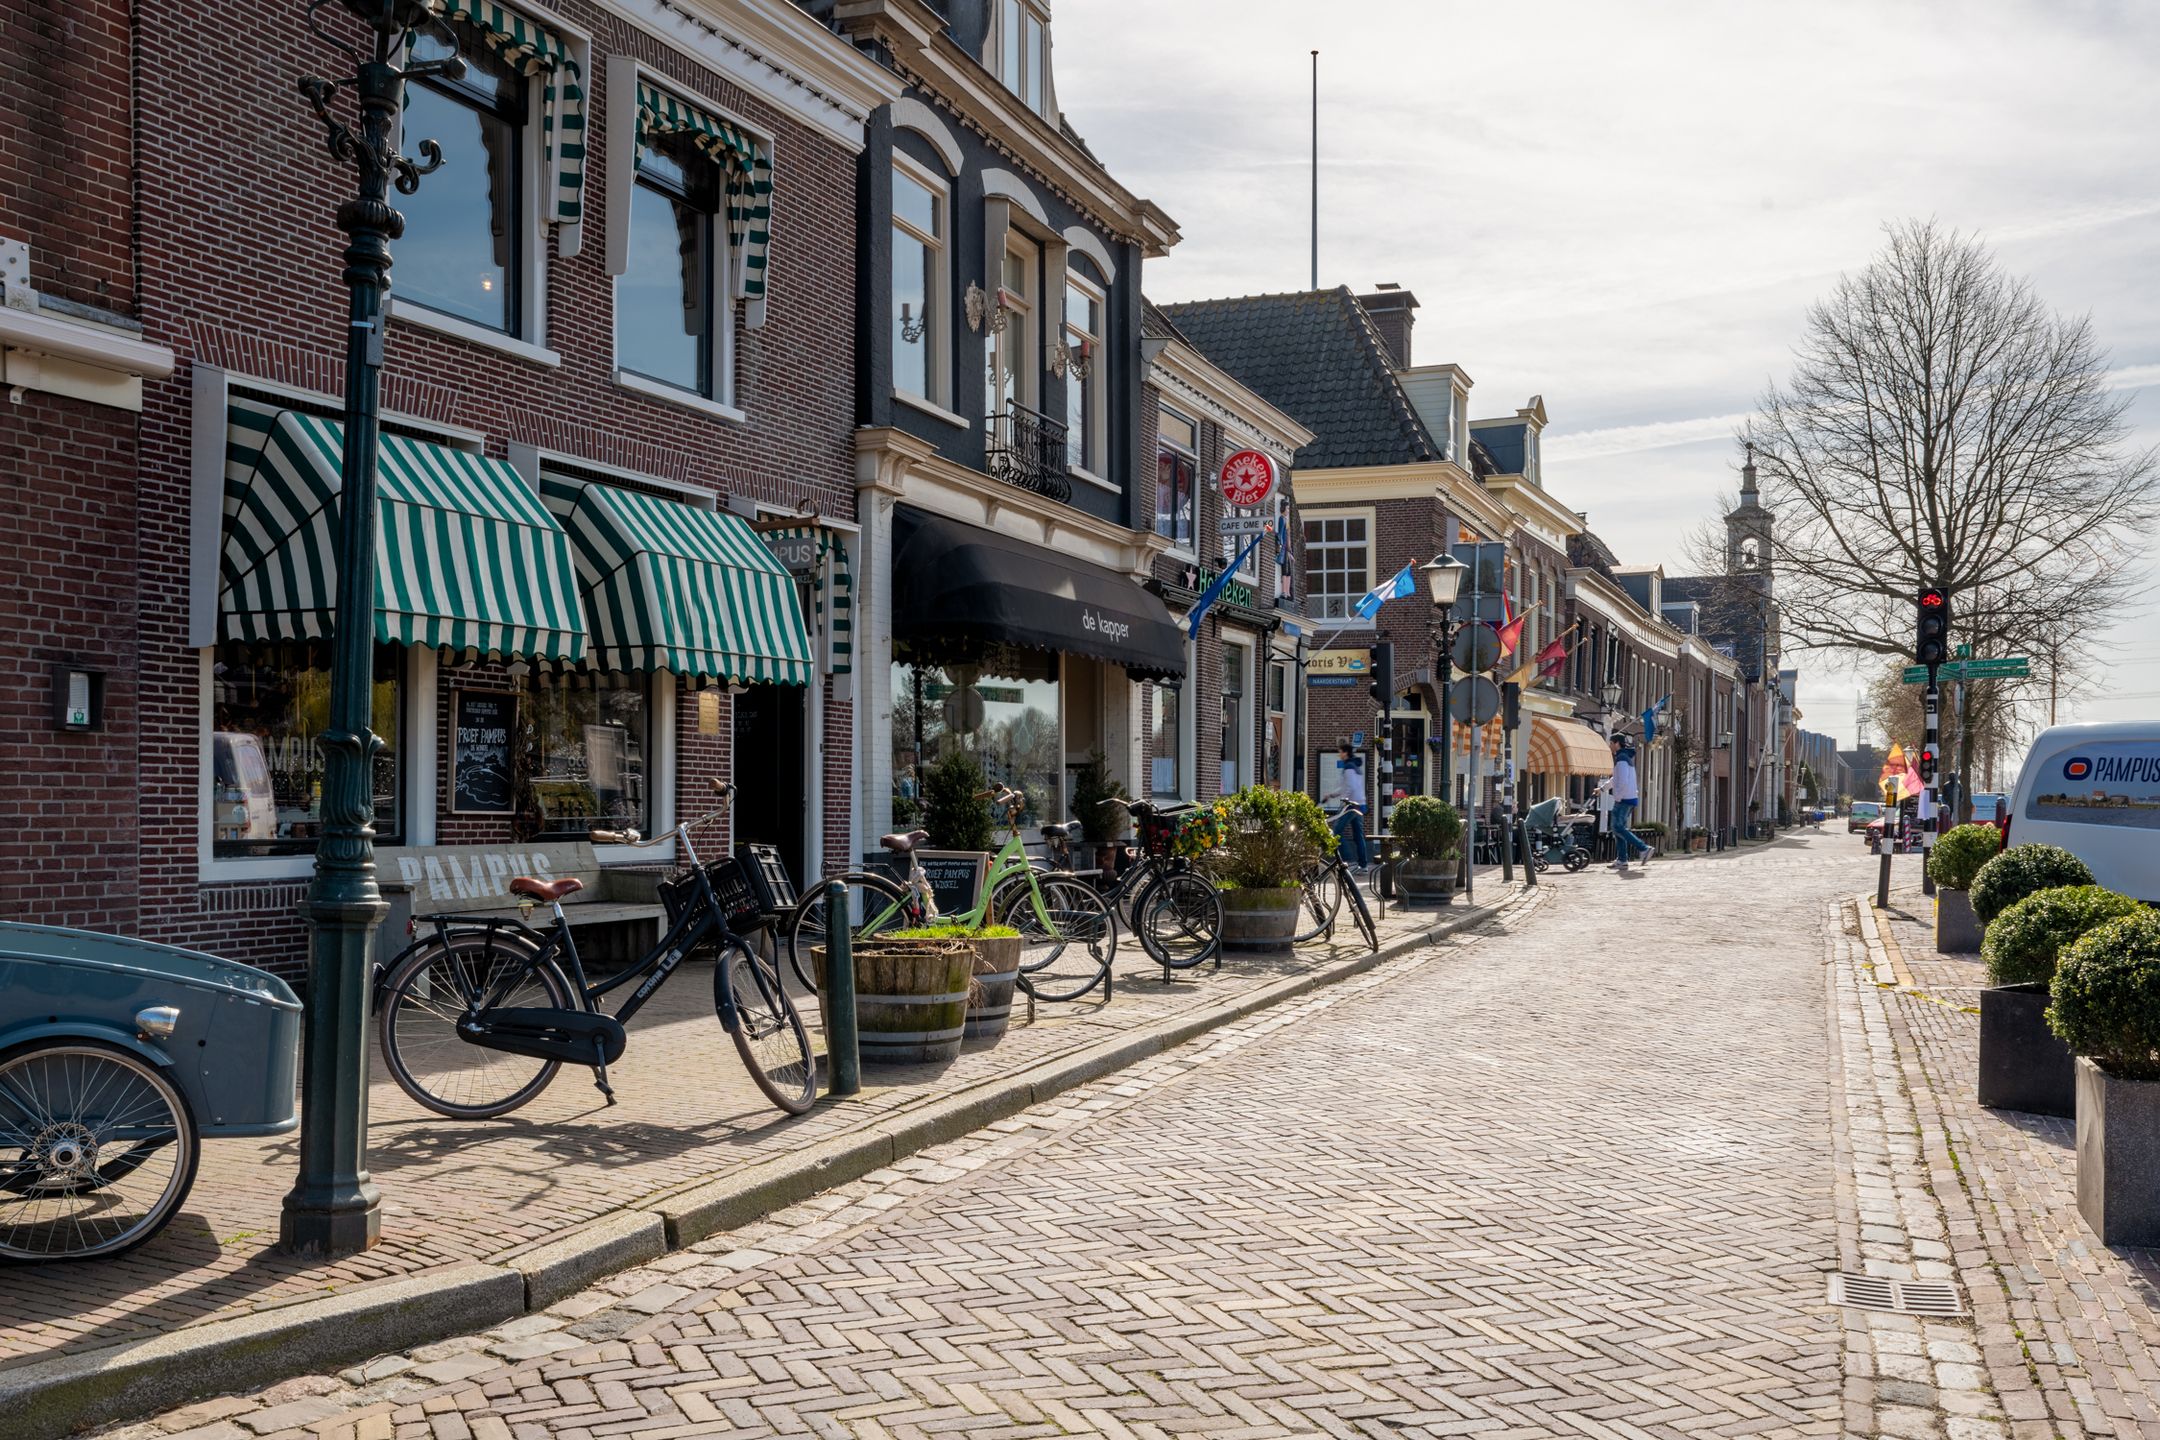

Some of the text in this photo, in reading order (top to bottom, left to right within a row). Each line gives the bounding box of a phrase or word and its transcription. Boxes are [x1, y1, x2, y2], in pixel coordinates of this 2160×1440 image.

[1223, 454, 1268, 489] Heineken's
[1232, 489, 1259, 503] Bier
[1221, 522, 1240, 530] CAFE
[1243, 520, 1259, 529] OME
[1082, 608, 1129, 643] de kapper
[480, 728, 507, 744] PAMPUS
[262, 735, 326, 773] MPUS
[2094, 757, 2160, 783] PAMPUS
[397, 852, 554, 901] PAMPUS
[926, 868, 971, 879] ROEF PAMPUS
